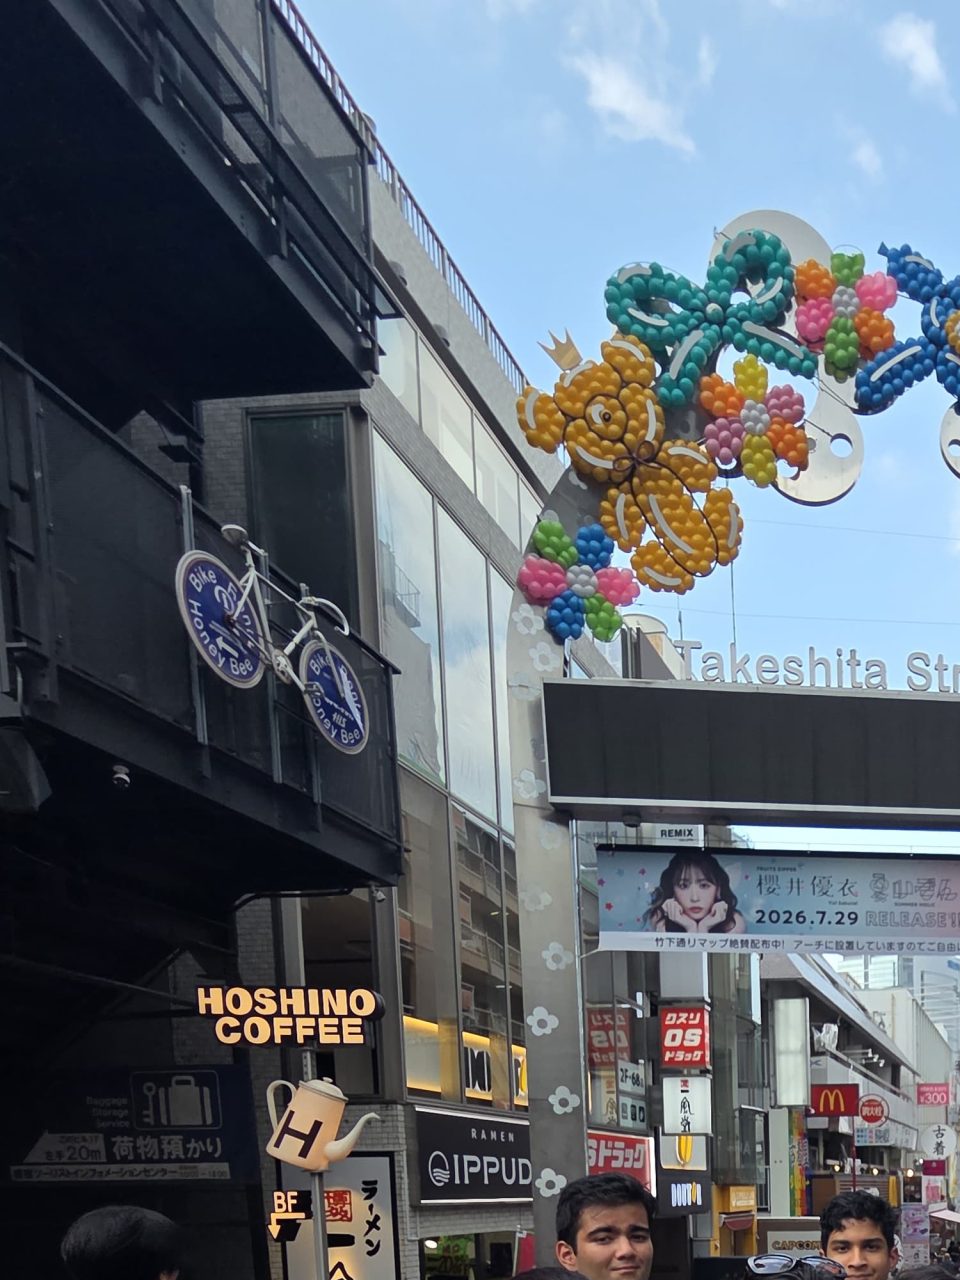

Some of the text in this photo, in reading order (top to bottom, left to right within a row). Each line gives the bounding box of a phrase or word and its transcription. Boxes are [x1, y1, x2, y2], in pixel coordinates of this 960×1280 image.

[189, 569, 217, 593] Bike
[188, 599, 226, 670] Honey
[230, 657, 254, 676] Bee
[674, 639, 888, 690] Takeshita
[660, 828, 694, 838] REMIX
[756, 873, 859, 897] 櫻井優衣
[755, 909, 859, 926] 2026.7.29
[197, 986, 376, 1016] HOSHINO
[214, 1016, 365, 1045] COFFEE
[665, 1012, 701, 1025] クスリ
[664, 1028, 703, 1047] OS
[664, 1050, 704, 1062] ドラッグ
[273, 1109, 323, 1159] H
[471, 1127, 515, 1142] RAMEN
[932, 1124, 946, 1156] 古着
[111, 1134, 222, 1161] 荷物預かり
[273, 1191, 298, 1213] BF
[361, 1179, 381, 1257] ラーメン
